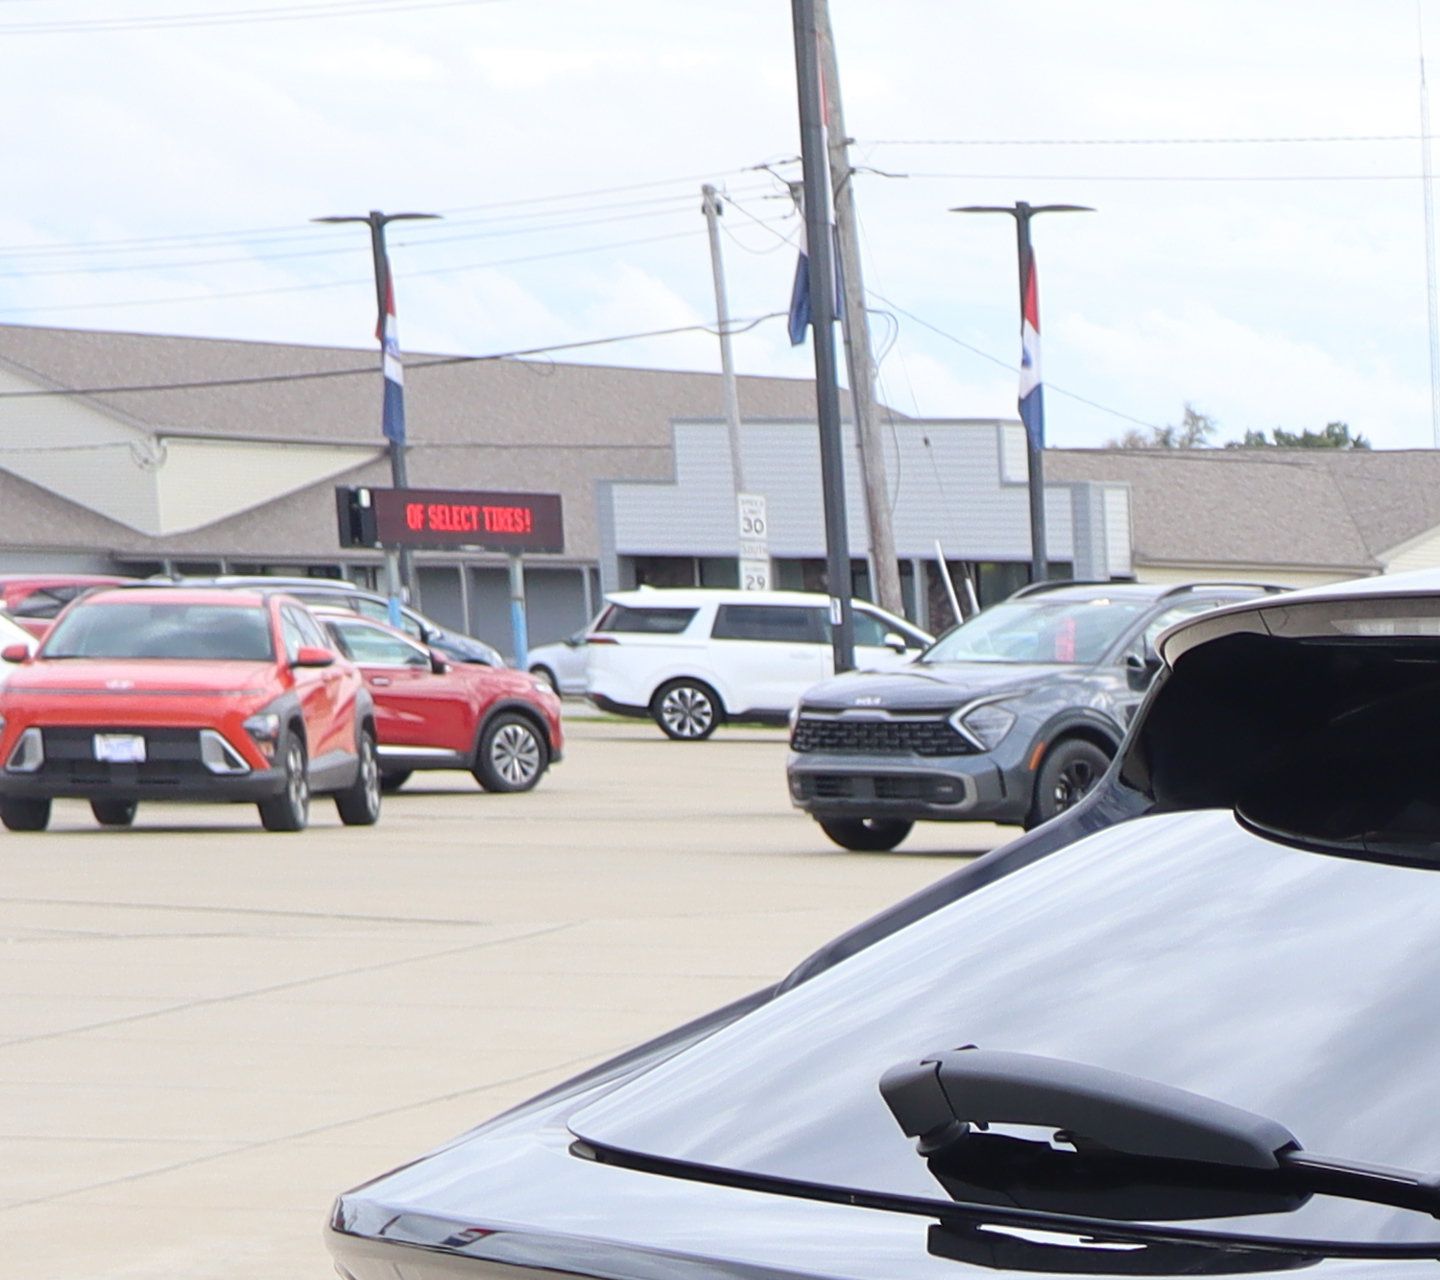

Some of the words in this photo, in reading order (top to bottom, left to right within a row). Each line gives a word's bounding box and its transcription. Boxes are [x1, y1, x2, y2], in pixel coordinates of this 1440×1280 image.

[406, 503, 425, 531] OF
[428, 504, 479, 531] SELECT
[481, 505, 532, 533] TIRES!
[743, 517, 765, 534] 30
[745, 575, 766, 591] 29
